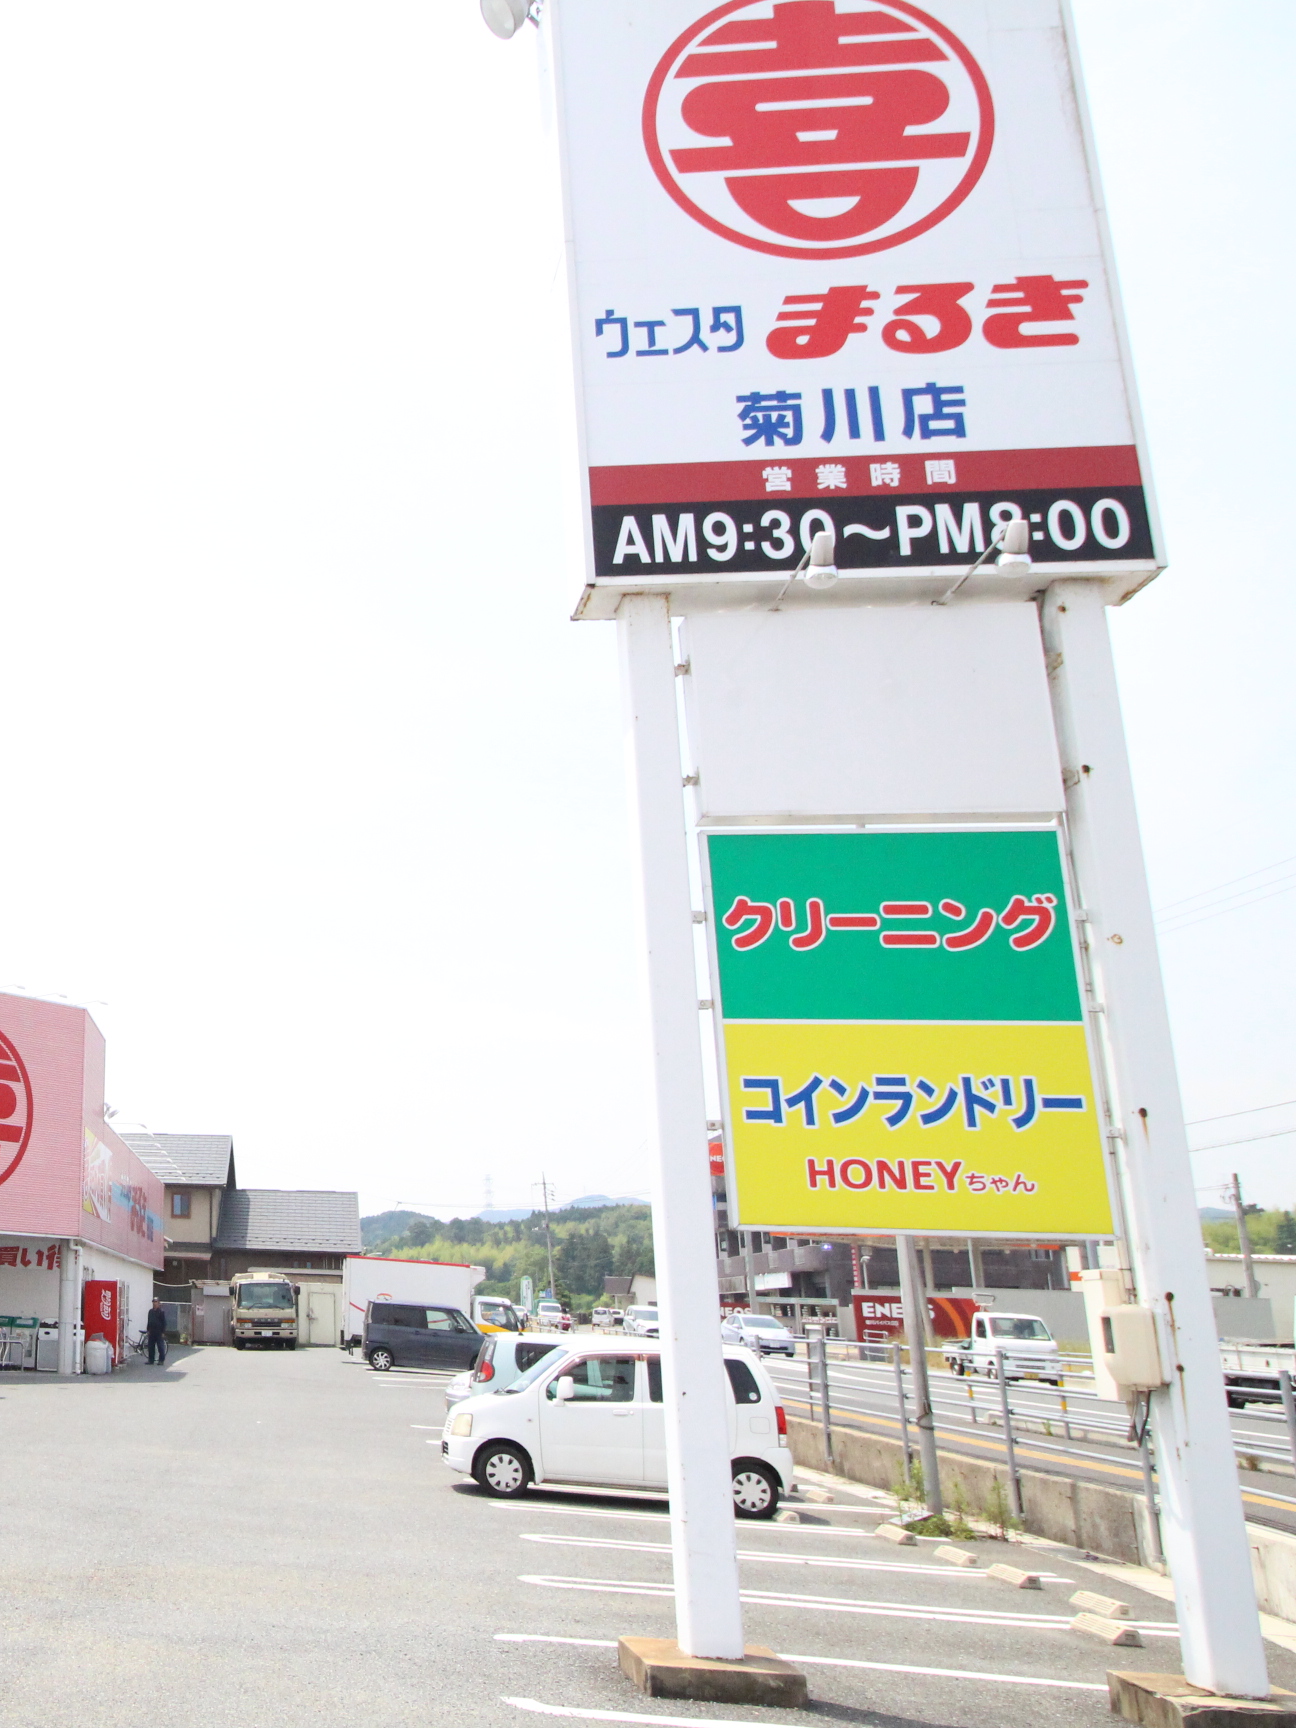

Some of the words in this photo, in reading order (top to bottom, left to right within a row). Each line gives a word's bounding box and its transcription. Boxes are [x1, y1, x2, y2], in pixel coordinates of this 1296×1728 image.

[766, 275, 1089, 360] まるき
[736, 382, 967, 447] 菊川店
[762, 459, 957, 492] 営業時間
[722, 893, 1058, 952] クリーニング
[741, 1073, 1085, 1130] コインランドリー
